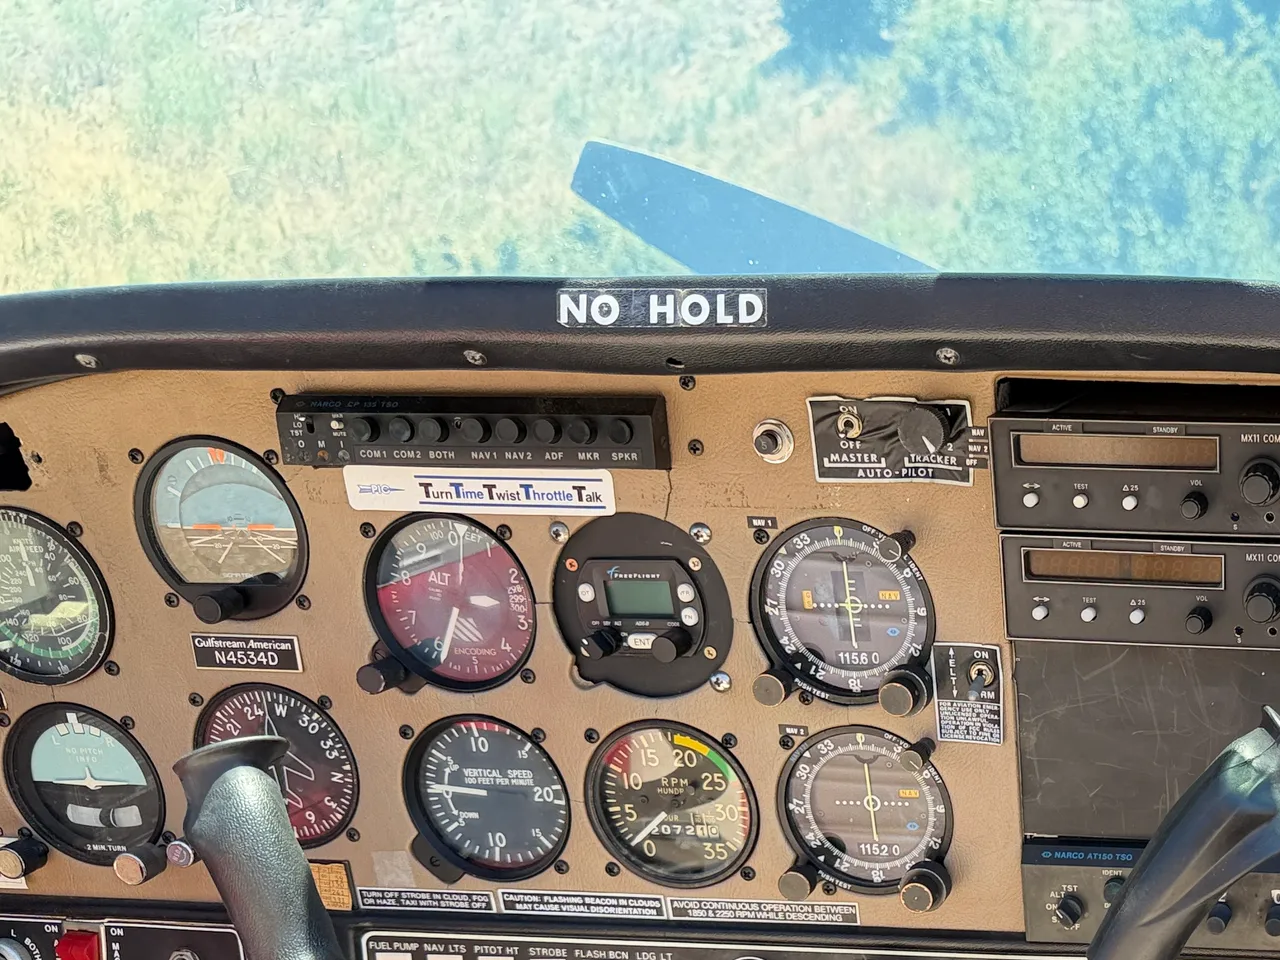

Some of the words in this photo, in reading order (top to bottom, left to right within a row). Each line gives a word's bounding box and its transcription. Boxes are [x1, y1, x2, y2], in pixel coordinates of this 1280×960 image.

[560, 294, 619, 325] NO
[650, 294, 763, 325] HOLD
[1051, 424, 1072, 432] ACTIVE
[1152, 426, 1178, 434] STANDBY
[1241, 434, 1260, 443] MX11
[840, 440, 861, 449] OFF
[429, 451, 455, 459] BOTH
[545, 452, 563, 460] ADF
[578, 452, 600, 460] MKR
[611, 452, 638, 461] SPKR
[830, 454, 878, 463] MASTER
[909, 454, 957, 465] TRACKER
[1190, 479, 1203, 487] VOL
[372, 485, 391, 494] PIC
[793, 534, 811, 549] 33
[428, 571, 451, 586] ALT
[194, 638, 245, 650] Gulfstream
[247, 640, 292, 650] American
[634, 638, 650, 646] ENT
[454, 647, 497, 656] ENCODING
[974, 651, 988, 659] ON
[215, 651, 279, 666] N4534D
[794, 678, 812, 693] PUSH
[812, 688, 830, 699] TEST
[243, 706, 264, 720] 24
[274, 704, 288, 717] W
[298, 717, 320, 735] 30
[470, 737, 489, 752] 10
[321, 740, 339, 760] 33
[641, 749, 659, 767] 15
[673, 750, 697, 768] 20
[463, 768, 502, 778] VERTICAL
[508, 770, 533, 779] SPEED
[497, 778, 510, 786] PER
[511, 778, 534, 787] MINUTE
[623, 773, 642, 790] 10
[702, 774, 726, 791] 25
[534, 786, 553, 802] 20
[715, 804, 739, 821] 30
[704, 845, 728, 860] 35
[1087, 852, 1113, 860] AT150
[1116, 853, 1132, 861] TSO
[673, 901, 699, 909] AVOID
[701, 902, 759, 911] CONTINUOUS
[761, 903, 812, 912] OPERATION
[814, 905, 856, 914] BETWEEN
[786, 913, 843, 922] DESCENDING
[369, 941, 391, 950] FUEL
[394, 942, 419, 951] PUMP
[424, 943, 444, 952] NAV
[449, 944, 466, 953] LTS
[474, 945, 502, 954] PITOT
[506, 946, 519, 955] HT
[529, 948, 567, 957] STROBE
[575, 950, 606, 959] FLASH
[609, 951, 629, 960] BCN
[636, 952, 656, 960] LDG
[660, 953, 672, 960] LT
